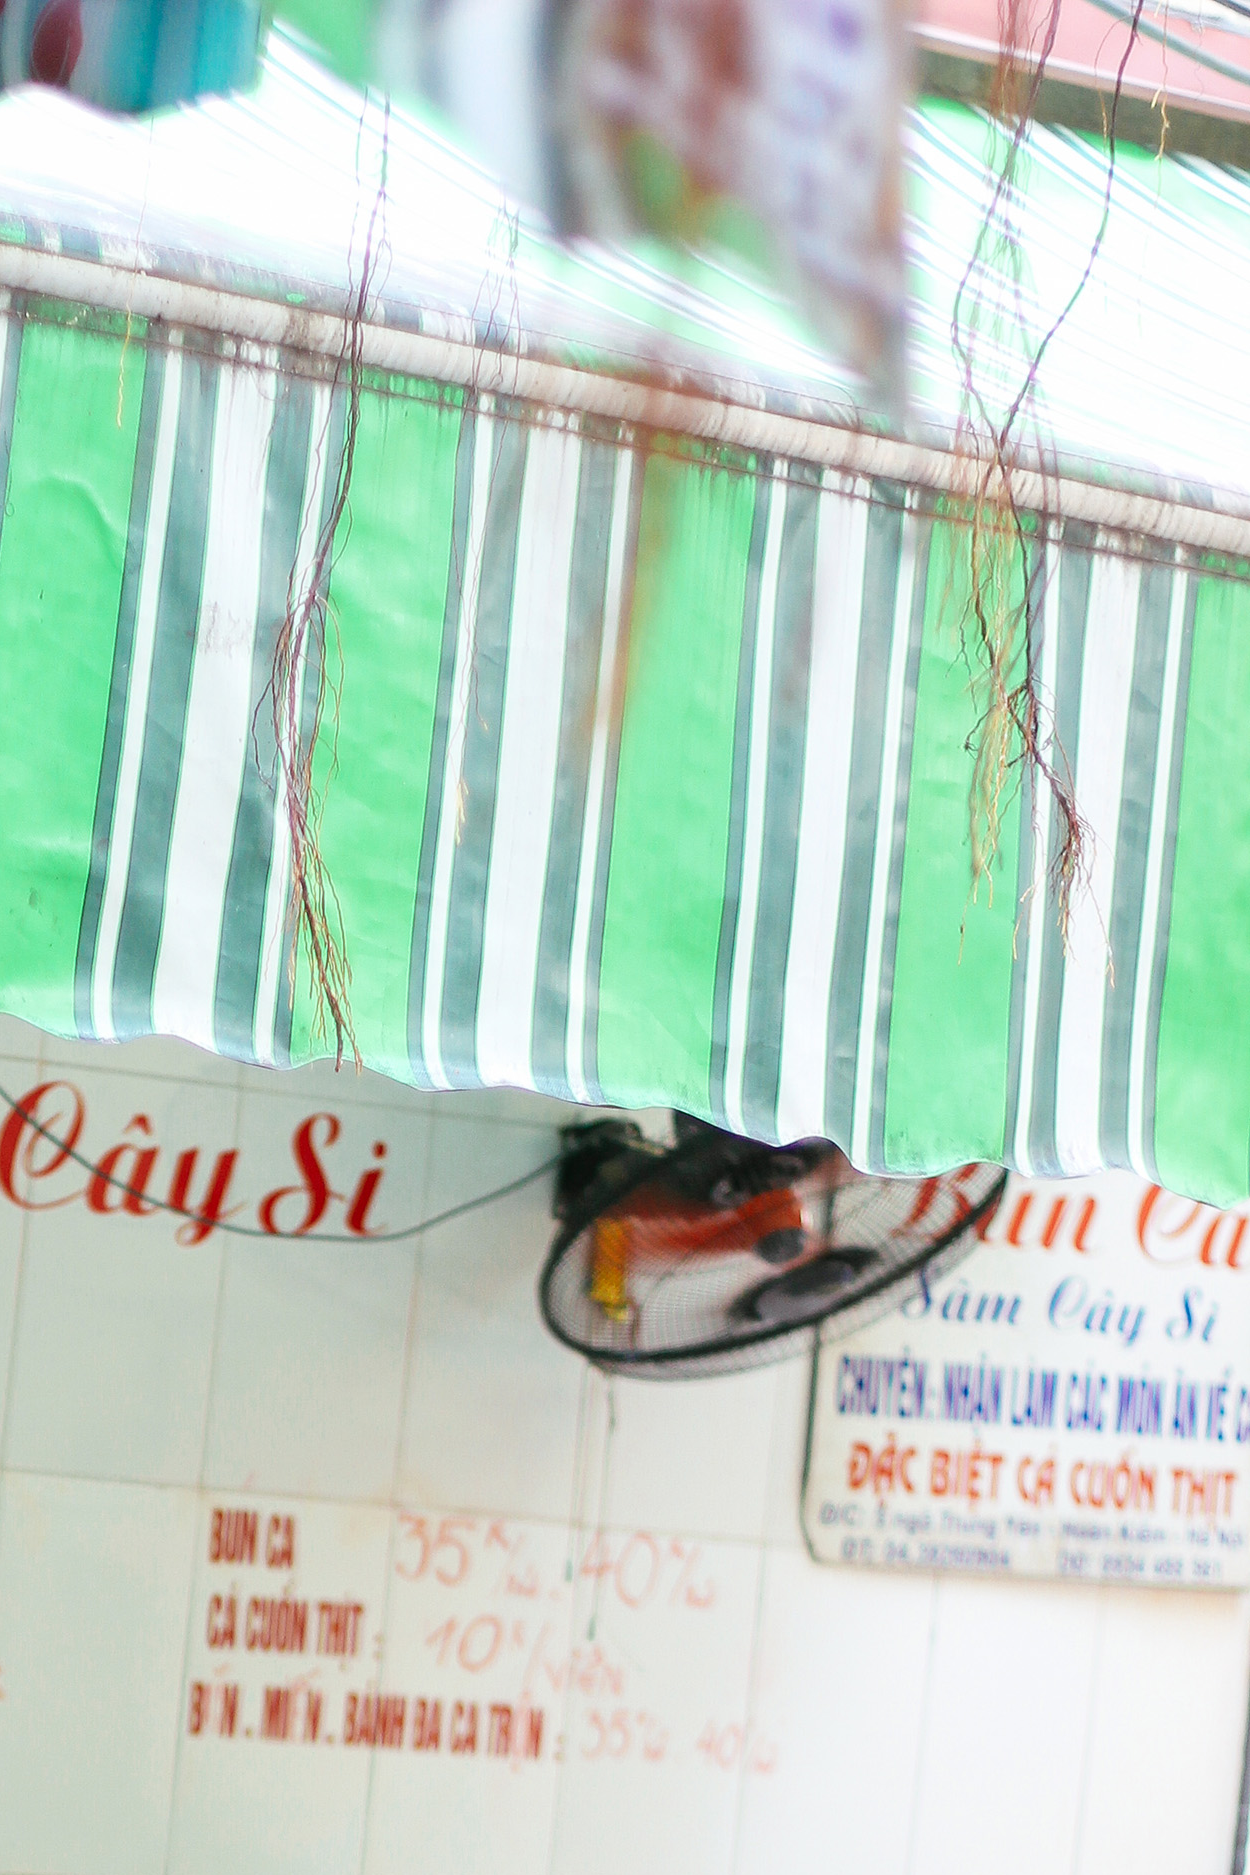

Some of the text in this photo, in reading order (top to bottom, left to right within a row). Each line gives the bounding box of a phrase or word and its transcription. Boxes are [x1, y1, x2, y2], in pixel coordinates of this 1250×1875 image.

[259, 1113, 389, 1238] Si
[1049, 1274, 1147, 1347] Cây
[1165, 1285, 1220, 1343] Si
[930, 1438, 1004, 1512] BIỆT
